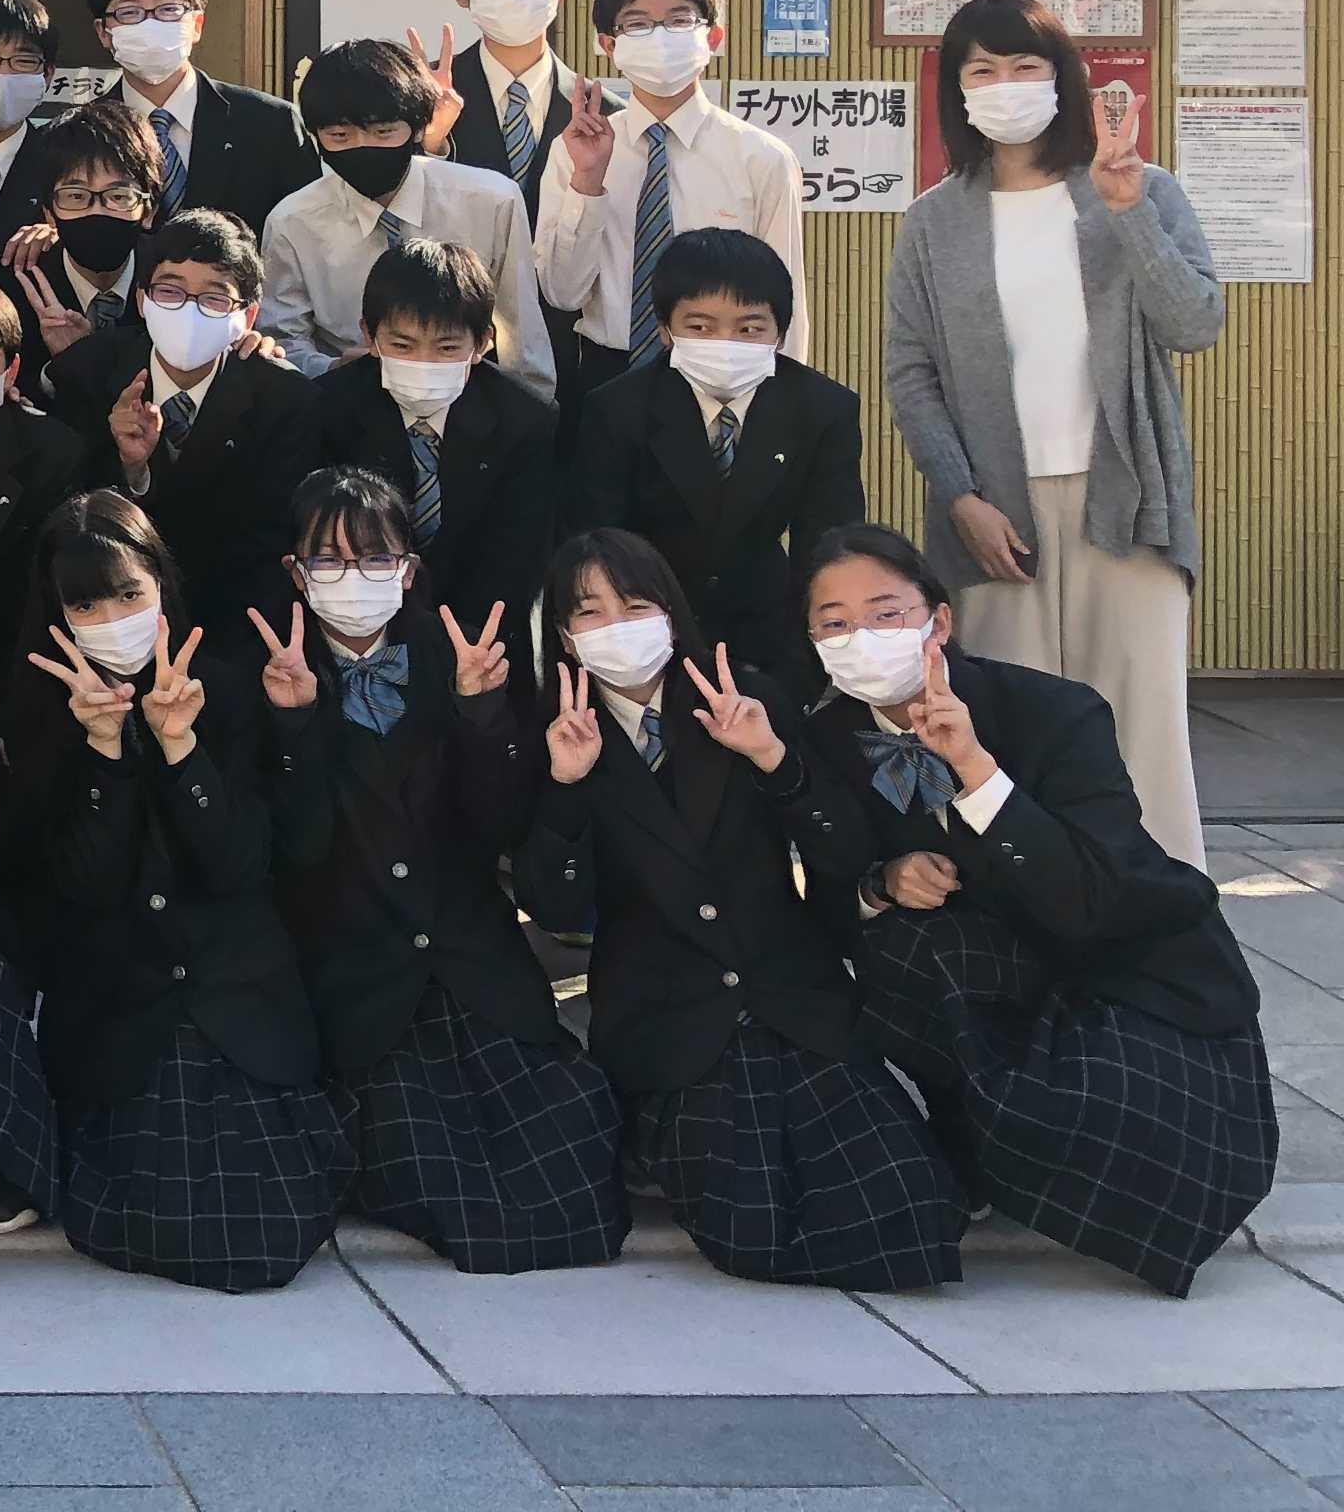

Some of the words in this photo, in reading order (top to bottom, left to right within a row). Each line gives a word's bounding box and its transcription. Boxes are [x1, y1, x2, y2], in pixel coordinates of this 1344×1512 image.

[736, 88, 906, 127] チケット売り場
[813, 136, 829, 156] は
